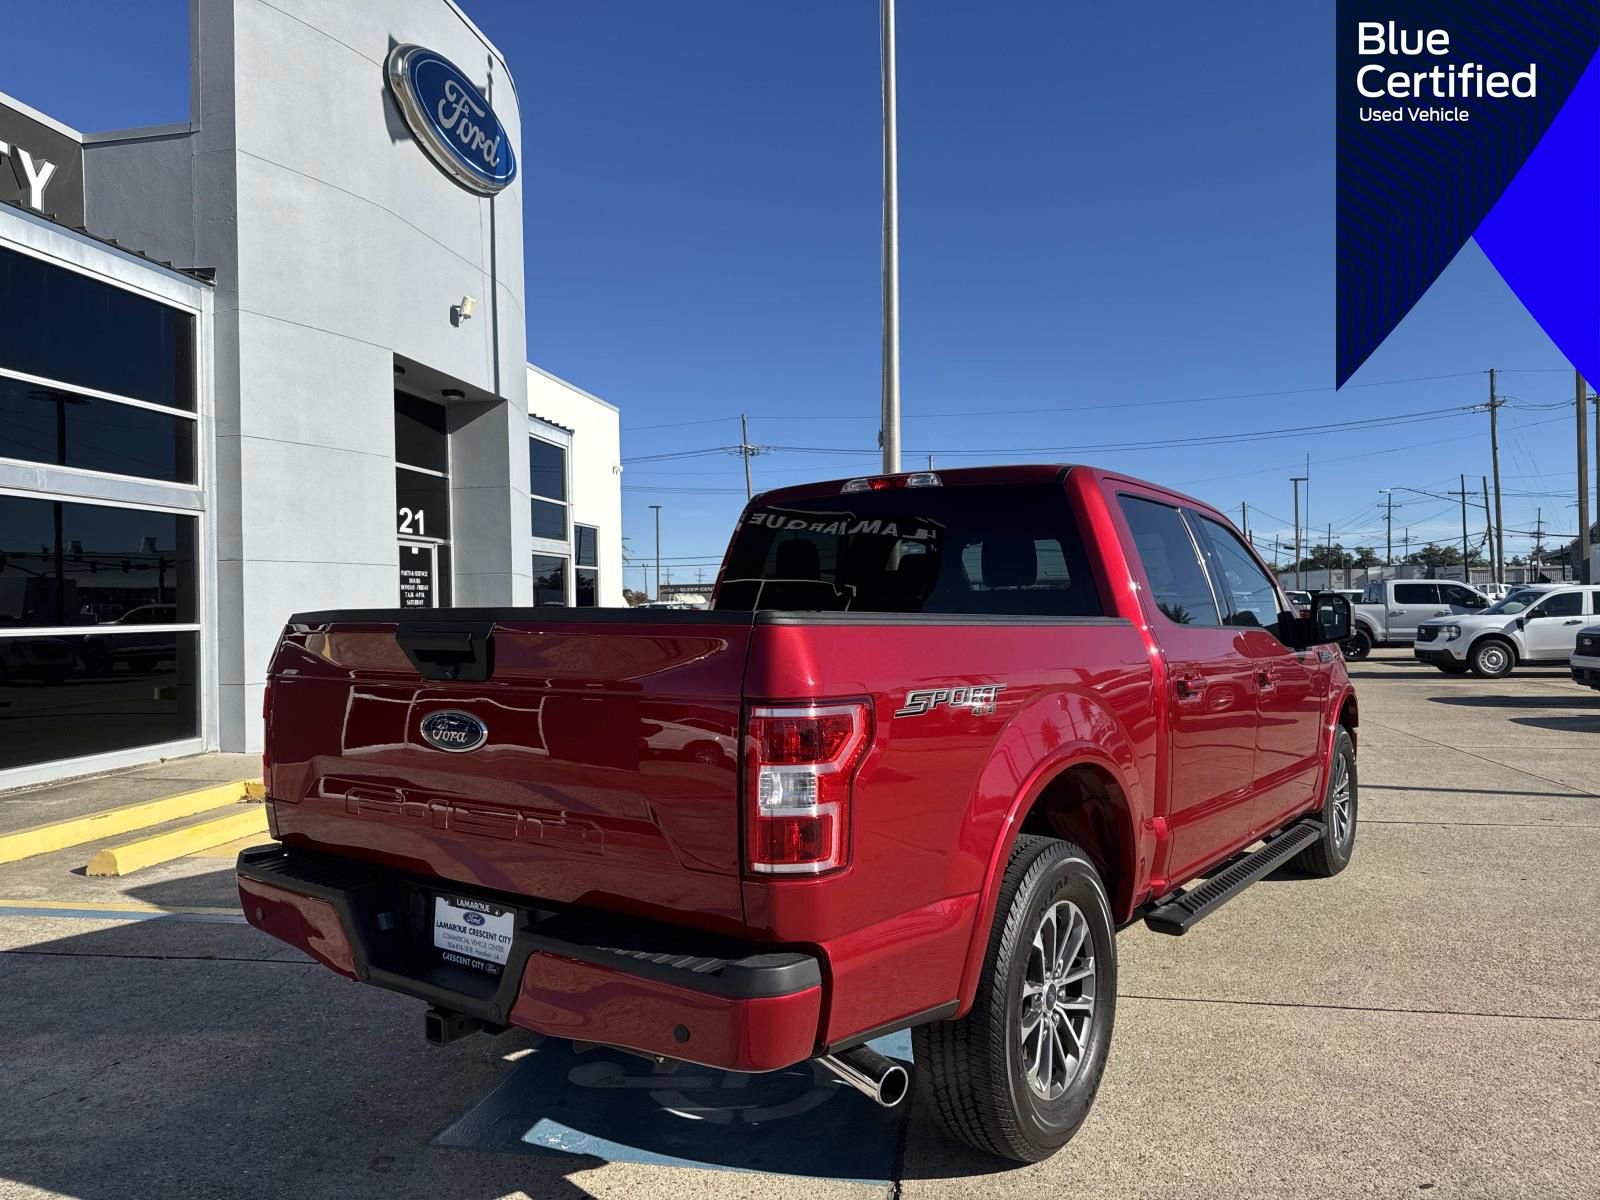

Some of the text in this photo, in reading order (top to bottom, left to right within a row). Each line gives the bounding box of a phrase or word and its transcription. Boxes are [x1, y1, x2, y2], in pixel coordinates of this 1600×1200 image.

[438, 79, 501, 168] Ford
[399, 507, 425, 535] 21
[893, 683, 1008, 718] SPORT
[431, 718, 470, 743] Ford
[456, 899, 491, 913] LAMARQUE
[465, 912, 482, 925] Ford
[436, 920, 512, 944] LAMARQUE CRESCENT CITY
[442, 952, 470, 966] CRESCENT
[471, 959, 484, 970] CITY
